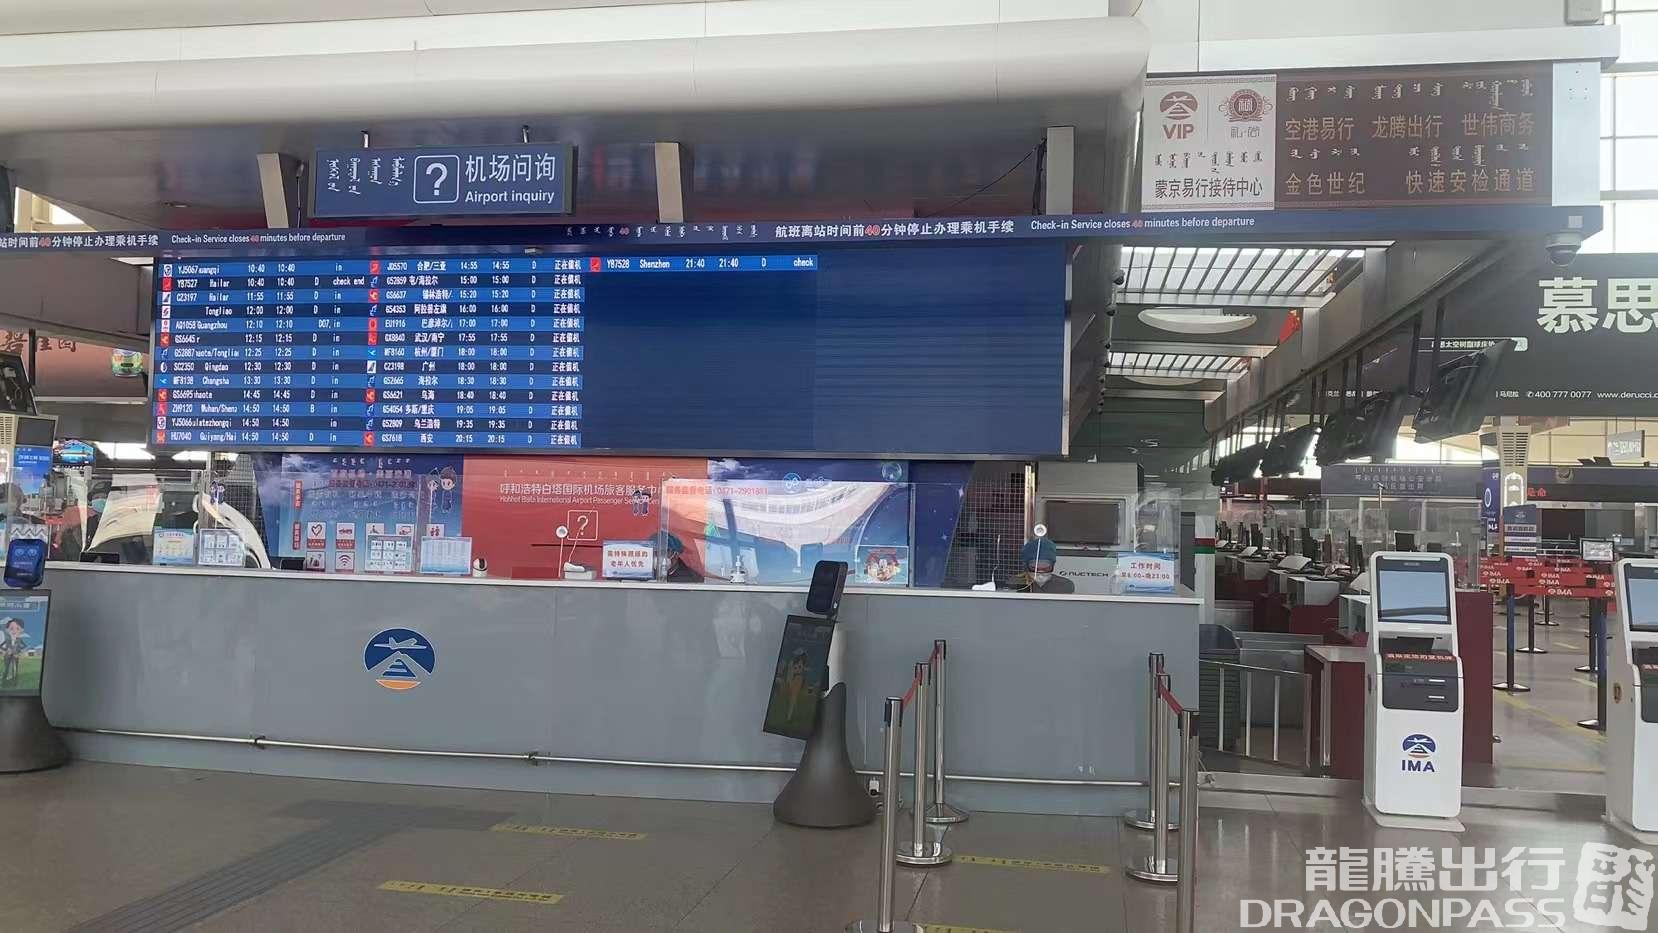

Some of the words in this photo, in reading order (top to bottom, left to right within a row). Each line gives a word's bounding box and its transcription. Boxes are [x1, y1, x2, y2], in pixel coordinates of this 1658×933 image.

[1284, 116, 1354, 142] 空港易行
[1372, 114, 1444, 140] 龙腾出行
[1462, 112, 1536, 138] 世伟商务
[1162, 124, 1194, 140] VIP
[465, 153, 556, 184] 机场问询
[1286, 172, 1366, 196] 金色世纪
[1406, 167, 1536, 194] 快速安检通道
[1154, 177, 1263, 199] 蒙京易行接待中心
[465, 191, 508, 205] Airport
[511, 190, 555, 204] inquiry
[1031, 219, 1069, 230] Check-in
[1071, 218, 1102, 230] Service
[1104, 218, 1131, 229] closes
[1144, 217, 1179, 227] minutes
[1181, 216, 1210, 227] before
[1212, 216, 1255, 228] departure
[171, 234, 202, 244] Check-in
[203, 233, 228, 244] Service
[228, 233, 249, 243] closes
[260, 232, 287, 242] minutes
[288, 231, 310, 242] before
[312, 230, 346, 242] departure
[460, 261, 478, 269] 14:55
[492, 261, 510, 269] 14:55
[639, 259, 670, 268] Shenzhen
[685, 258, 705, 268] 21:40
[718, 258, 739, 267] 21:40
[793, 257, 813, 266] check
[248, 264, 265, 272] 10:40
[278, 263, 295, 272] 10:40
[247, 278, 264, 286] 10:40
[277, 277, 294, 286] 10:40
[332, 277, 351, 285] check
[353, 276, 365, 285] end
[460, 276, 478, 284] 15:00
[492, 275, 509, 284] 15:00
[247, 292, 264, 300] 11:55
[276, 291, 294, 300] 11:55
[460, 290, 477, 298] 15:20
[492, 289, 509, 298] 15:20
[246, 306, 264, 314] 12:00
[276, 305, 294, 314] 12:00
[459, 304, 476, 312] 16:00
[491, 304, 508, 312] 16:00
[1536, 276, 1658, 334] 慕思
[246, 320, 263, 328] 12:10
[275, 319, 293, 328] 12:10
[459, 319, 476, 327] 17:00
[491, 319, 508, 327] 17:00
[245, 334, 262, 342] 12:15
[275, 333, 292, 342] 12:15
[458, 333, 476, 341] 17:55
[490, 333, 508, 341] 17:55
[244, 348, 262, 356] 12:25
[274, 347, 292, 356] 12:25
[458, 348, 475, 356] 18:00
[490, 347, 507, 356] 18:00
[244, 362, 262, 370] 12:30
[274, 361, 292, 370] 12:30
[458, 362, 475, 370] 18:00
[490, 362, 507, 370] 18:00
[243, 376, 261, 384] 13:30
[274, 376, 291, 384] 13:30
[457, 376, 474, 384] 18:30
[489, 376, 506, 385] 18:30
[243, 390, 260, 398] 14:45
[273, 390, 290, 398] 14:45
[456, 391, 474, 399] 18:40
[489, 391, 506, 399] 18:40
[242, 404, 260, 412] 14:50
[272, 404, 290, 412] 14:50
[456, 405, 474, 413] 19:05
[488, 406, 506, 414] 19:05
[242, 418, 260, 427] 14:50
[272, 418, 289, 426] 14:50
[456, 420, 474, 428] 19:35
[488, 420, 506, 428] 19:35
[241, 432, 259, 441] 14:50
[271, 432, 289, 441] 14:50
[455, 434, 473, 442] 20:15
[487, 434, 505, 443] 20:15
[1401, 760, 1435, 772] IMA
